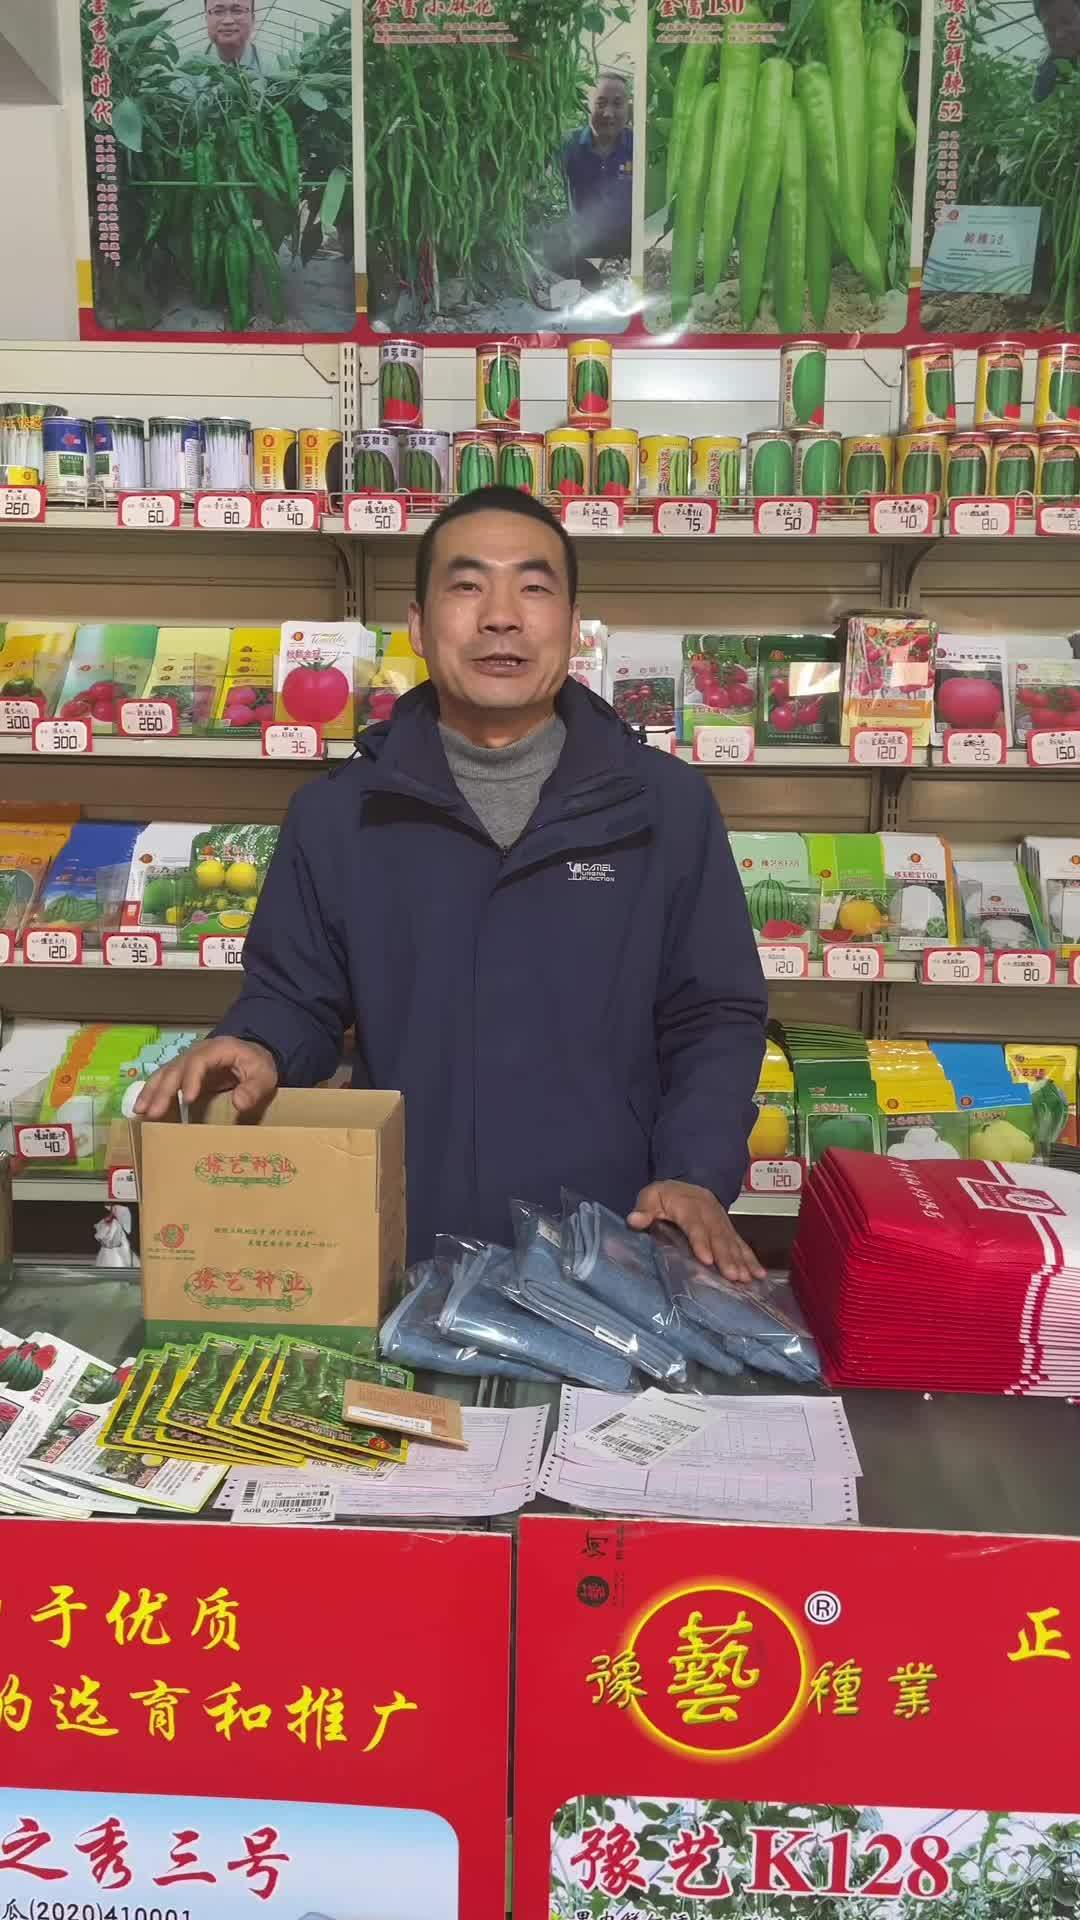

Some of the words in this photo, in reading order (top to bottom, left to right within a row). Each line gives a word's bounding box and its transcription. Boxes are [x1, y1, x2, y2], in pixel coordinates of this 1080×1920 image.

[4, 502, 30, 520] 260
[147, 509, 165, 524] 60
[223, 511, 240, 525] 80
[286, 510, 304, 526] 40
[374, 514, 392, 530] 50
[684, 514, 702, 532] 75
[783, 516, 802, 532] 50
[899, 511, 918, 529] 40
[981, 517, 999, 531] 80
[6, 712, 31, 730] 300
[138, 716, 163, 732] 260
[53, 735, 78, 750] 300
[291, 741, 307, 754] 35
[714, 745, 739, 759] 240
[877, 745, 897, 760] 120
[974, 745, 991, 761] 25
[1055, 742, 1076, 760] 150
[581, 863, 616, 872] CAMEL
[48, 947, 67, 960] 120
[131, 949, 148, 963] 35
[773, 960, 794, 974] 120
[852, 962, 870, 976] 40
[953, 965, 970, 978] 80
[1023, 968, 1040, 982] 80
[44, 1140, 61, 1153] 40
[207, 1153, 294, 1176] 豫艺种业
[772, 1174, 792, 1188] 120
[195, 1268, 306, 1295] 豫艺种业
[0, 1584, 240, 1651] 于优质
[1007, 1607, 1071, 1662] 正
[1, 1816, 290, 1900] 之秀三号
[570, 1825, 951, 1899] 豫艺K128
